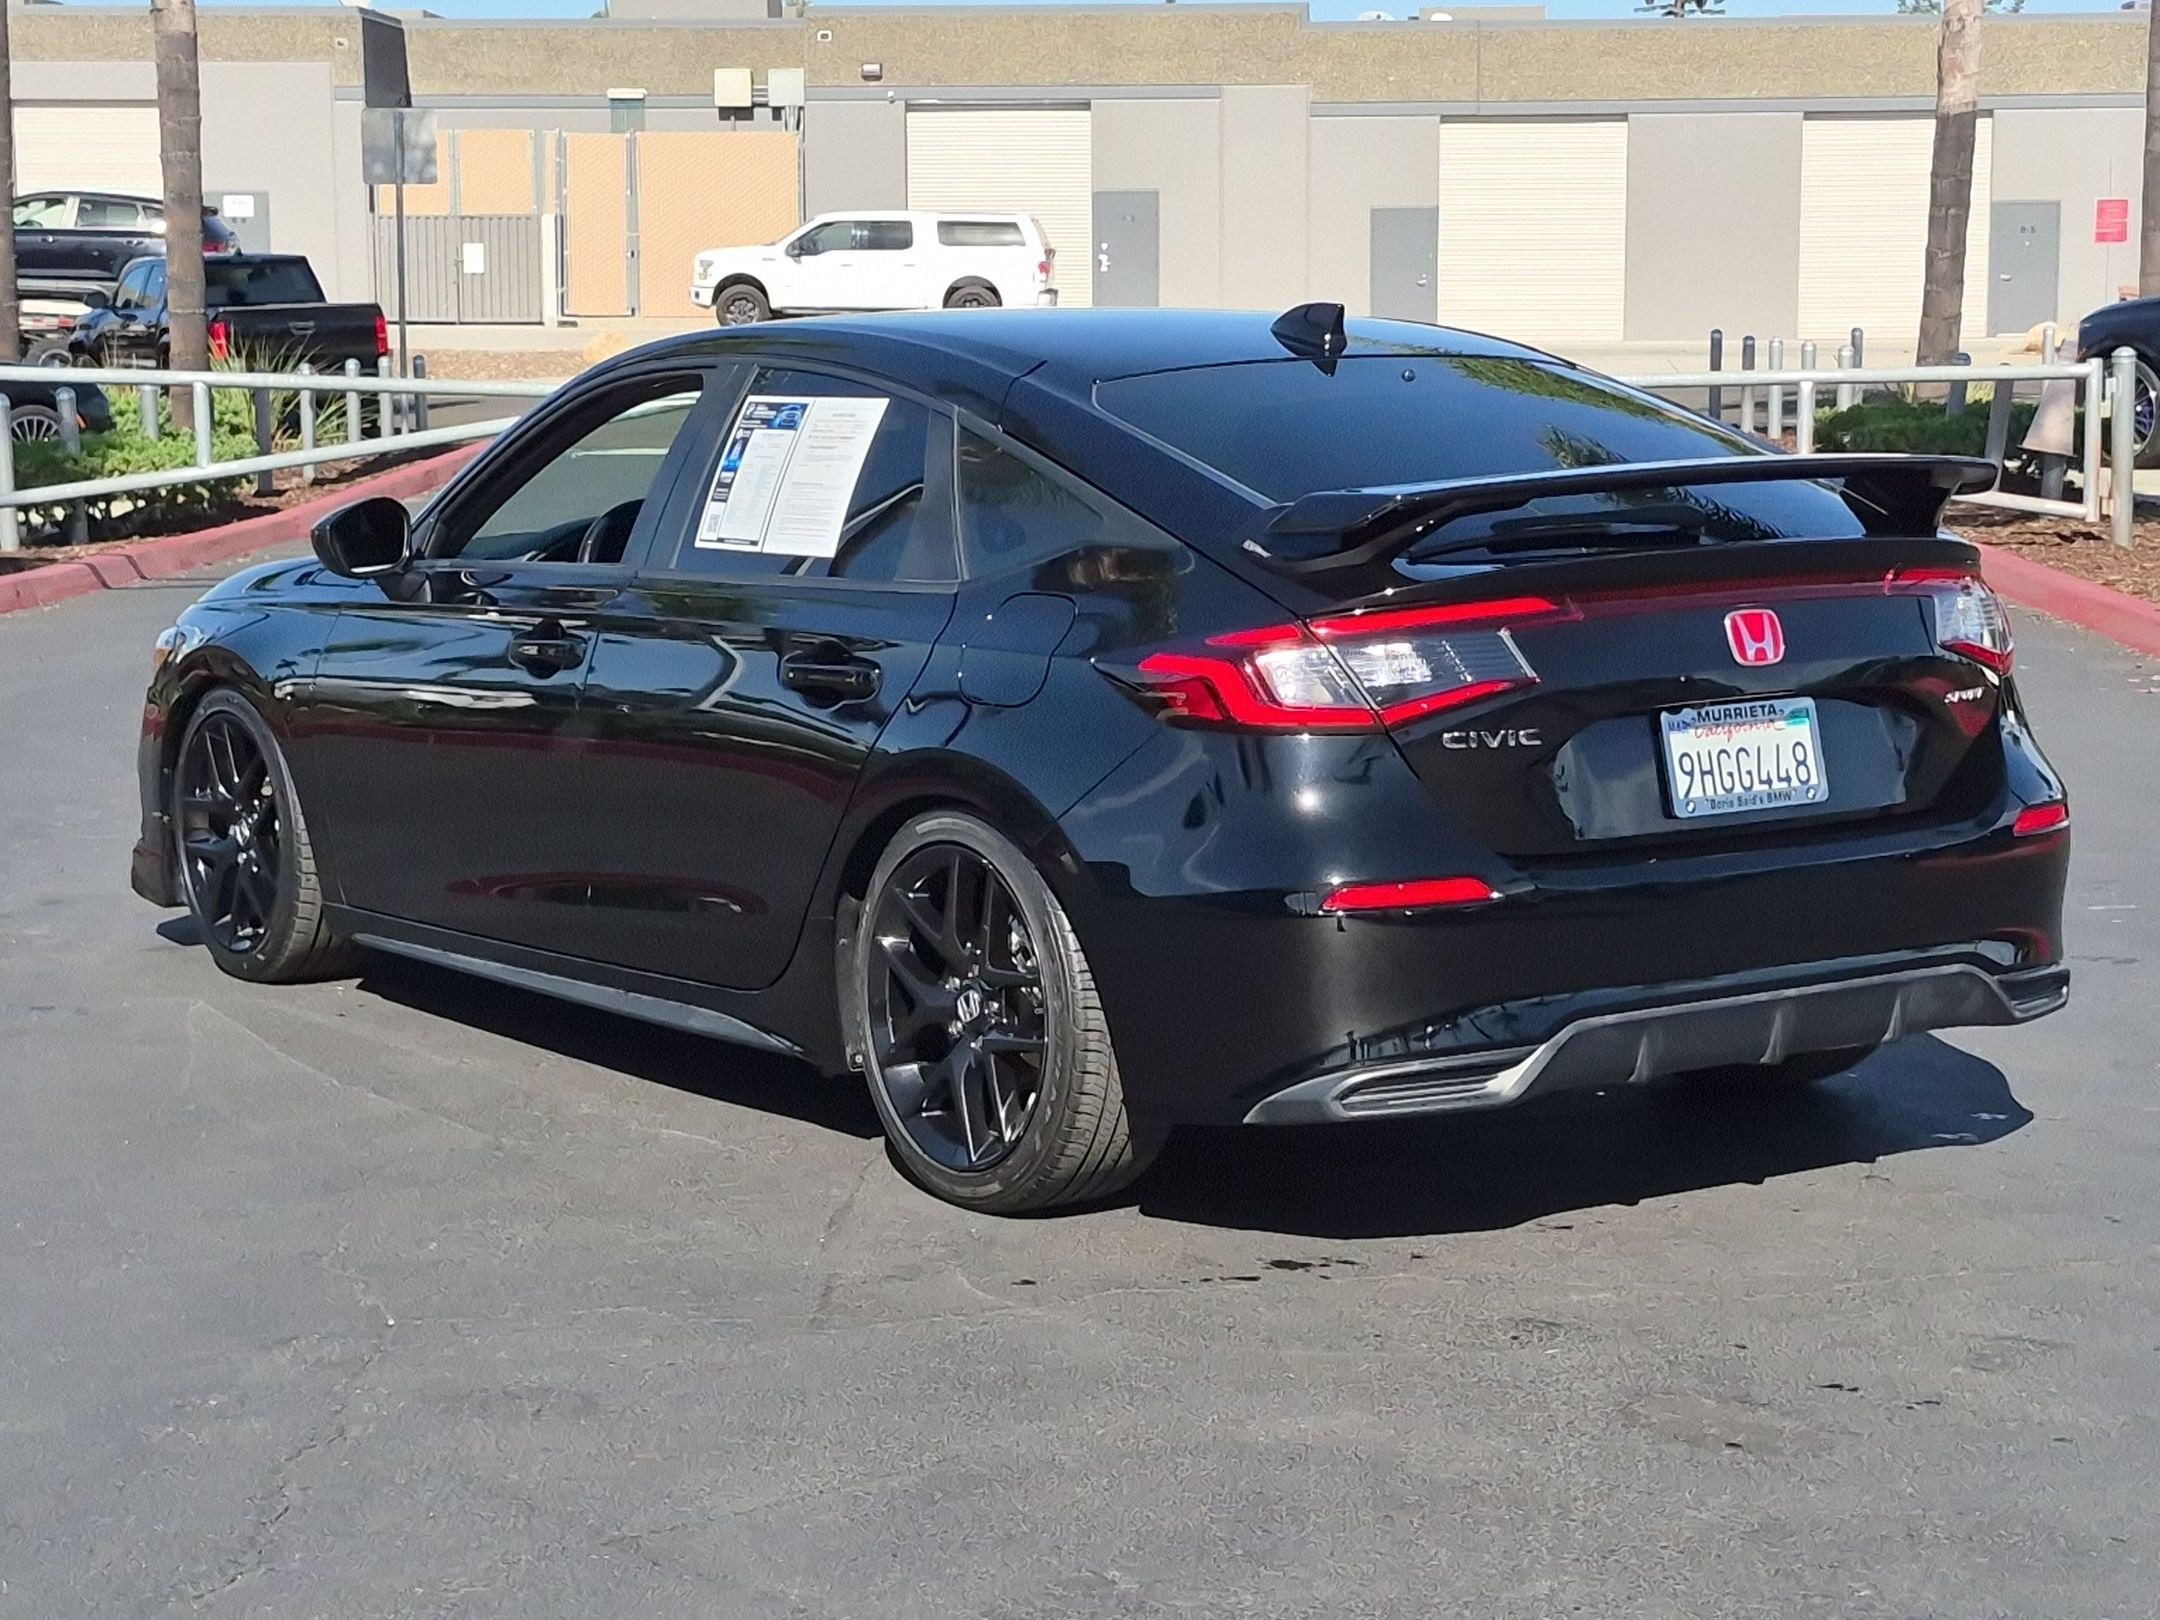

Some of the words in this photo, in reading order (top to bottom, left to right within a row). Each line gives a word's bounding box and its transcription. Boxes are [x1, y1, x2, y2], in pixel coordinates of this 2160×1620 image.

[1697, 703, 1777, 723] MURRIETA
[1443, 728, 1542, 749] CIVIC
[1678, 741, 1811, 799] 9HGG448
